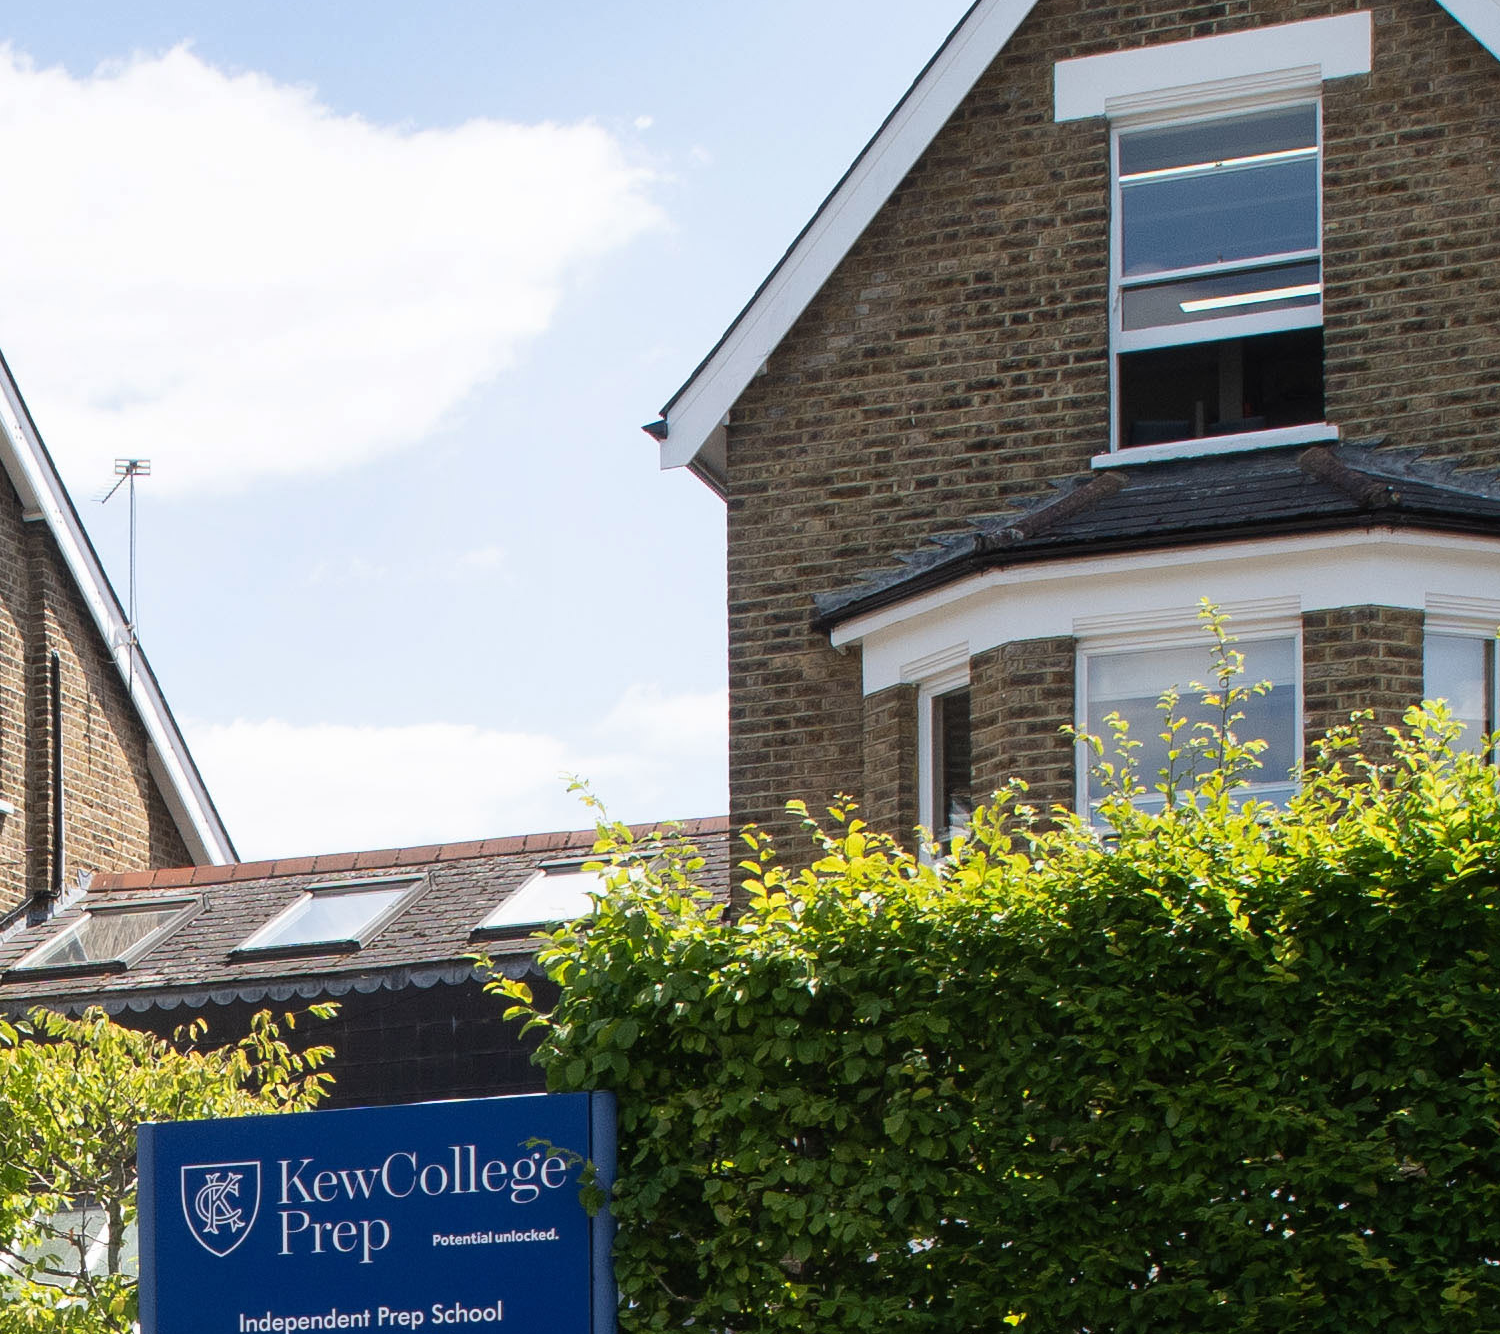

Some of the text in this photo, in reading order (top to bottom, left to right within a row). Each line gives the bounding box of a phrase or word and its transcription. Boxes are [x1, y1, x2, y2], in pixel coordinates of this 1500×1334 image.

[277, 1210, 390, 1264] Prep
[432, 1227, 560, 1247] Potential unlocked.
[378, 1306, 425, 1331] Prep
[431, 1300, 502, 1324] School
